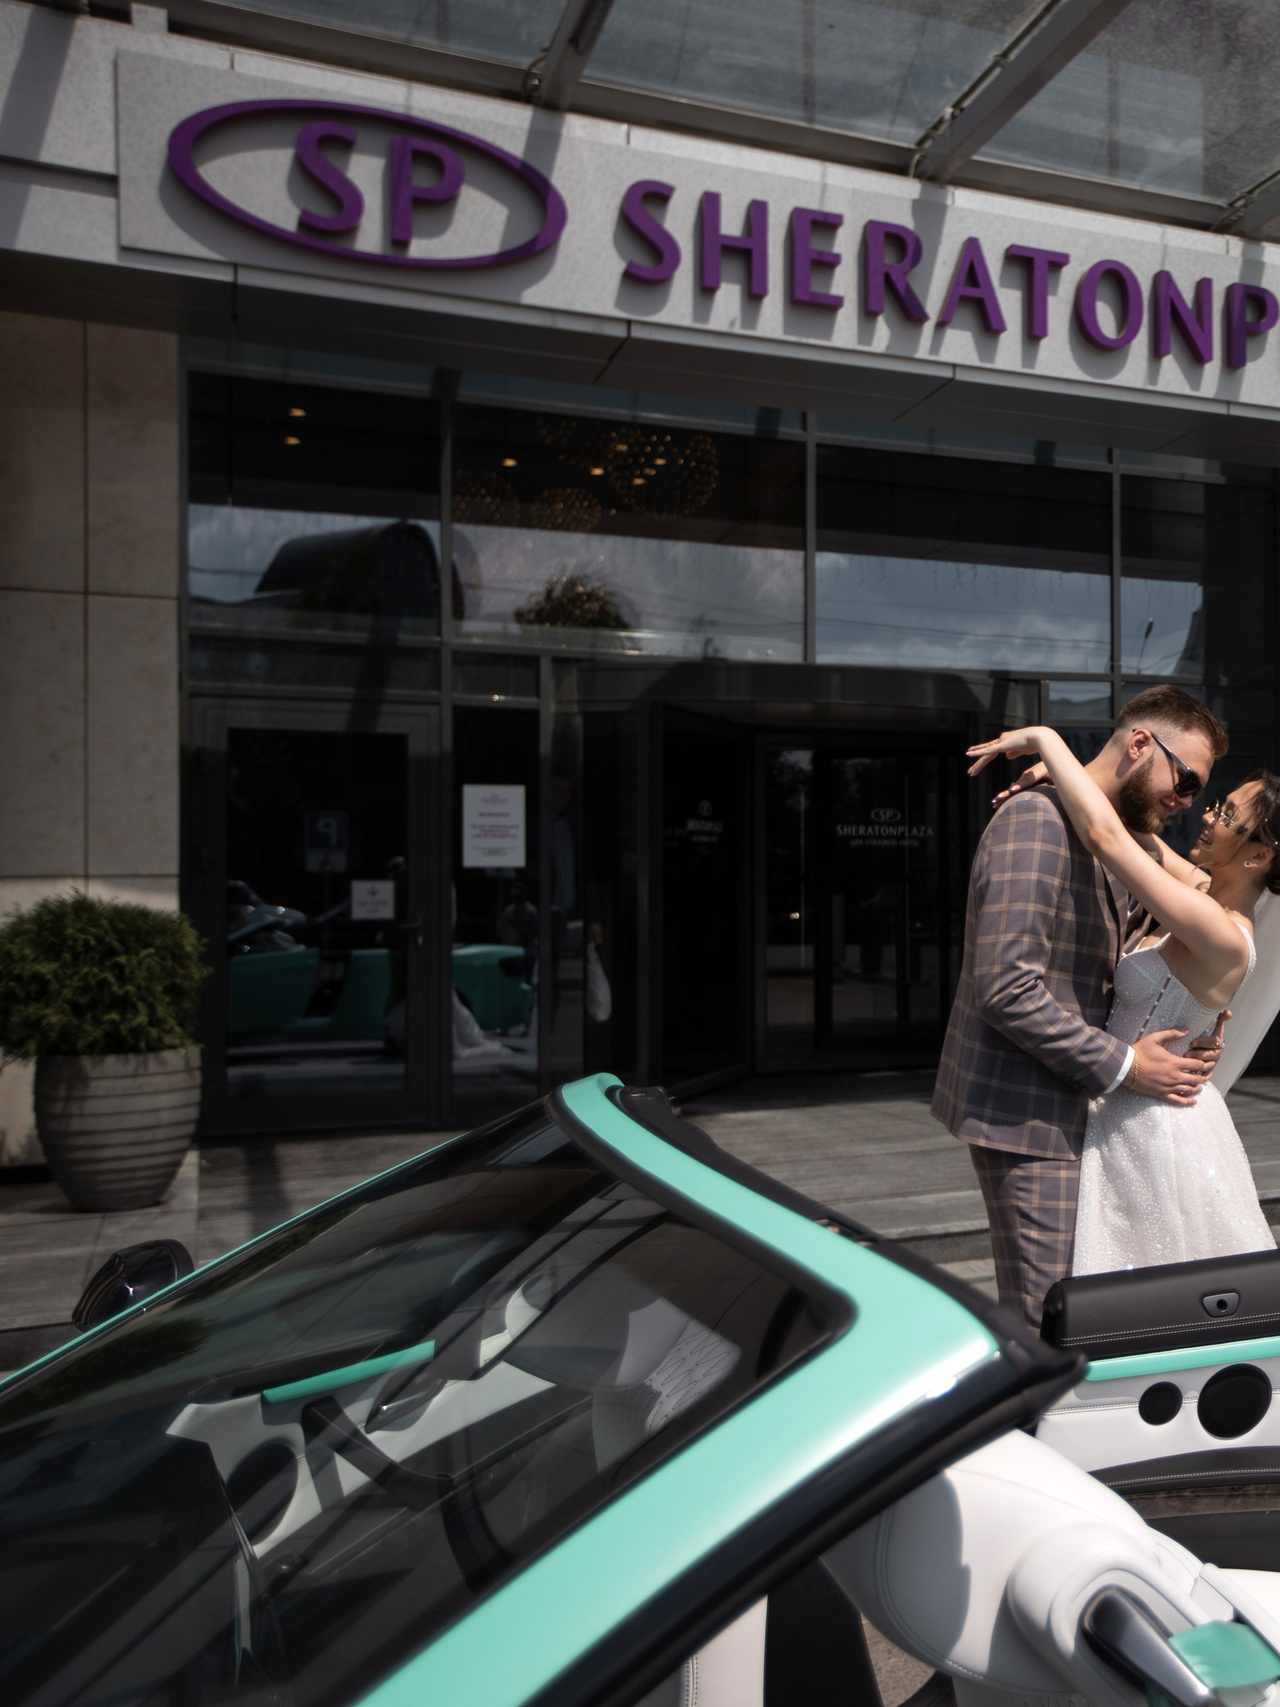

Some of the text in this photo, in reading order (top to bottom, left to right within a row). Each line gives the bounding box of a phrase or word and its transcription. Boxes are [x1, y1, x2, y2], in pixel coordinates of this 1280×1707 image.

[295, 122, 465, 247] SP
[879, 809, 893, 821] SP
[836, 825, 934, 837] SHERATONPLAZA
